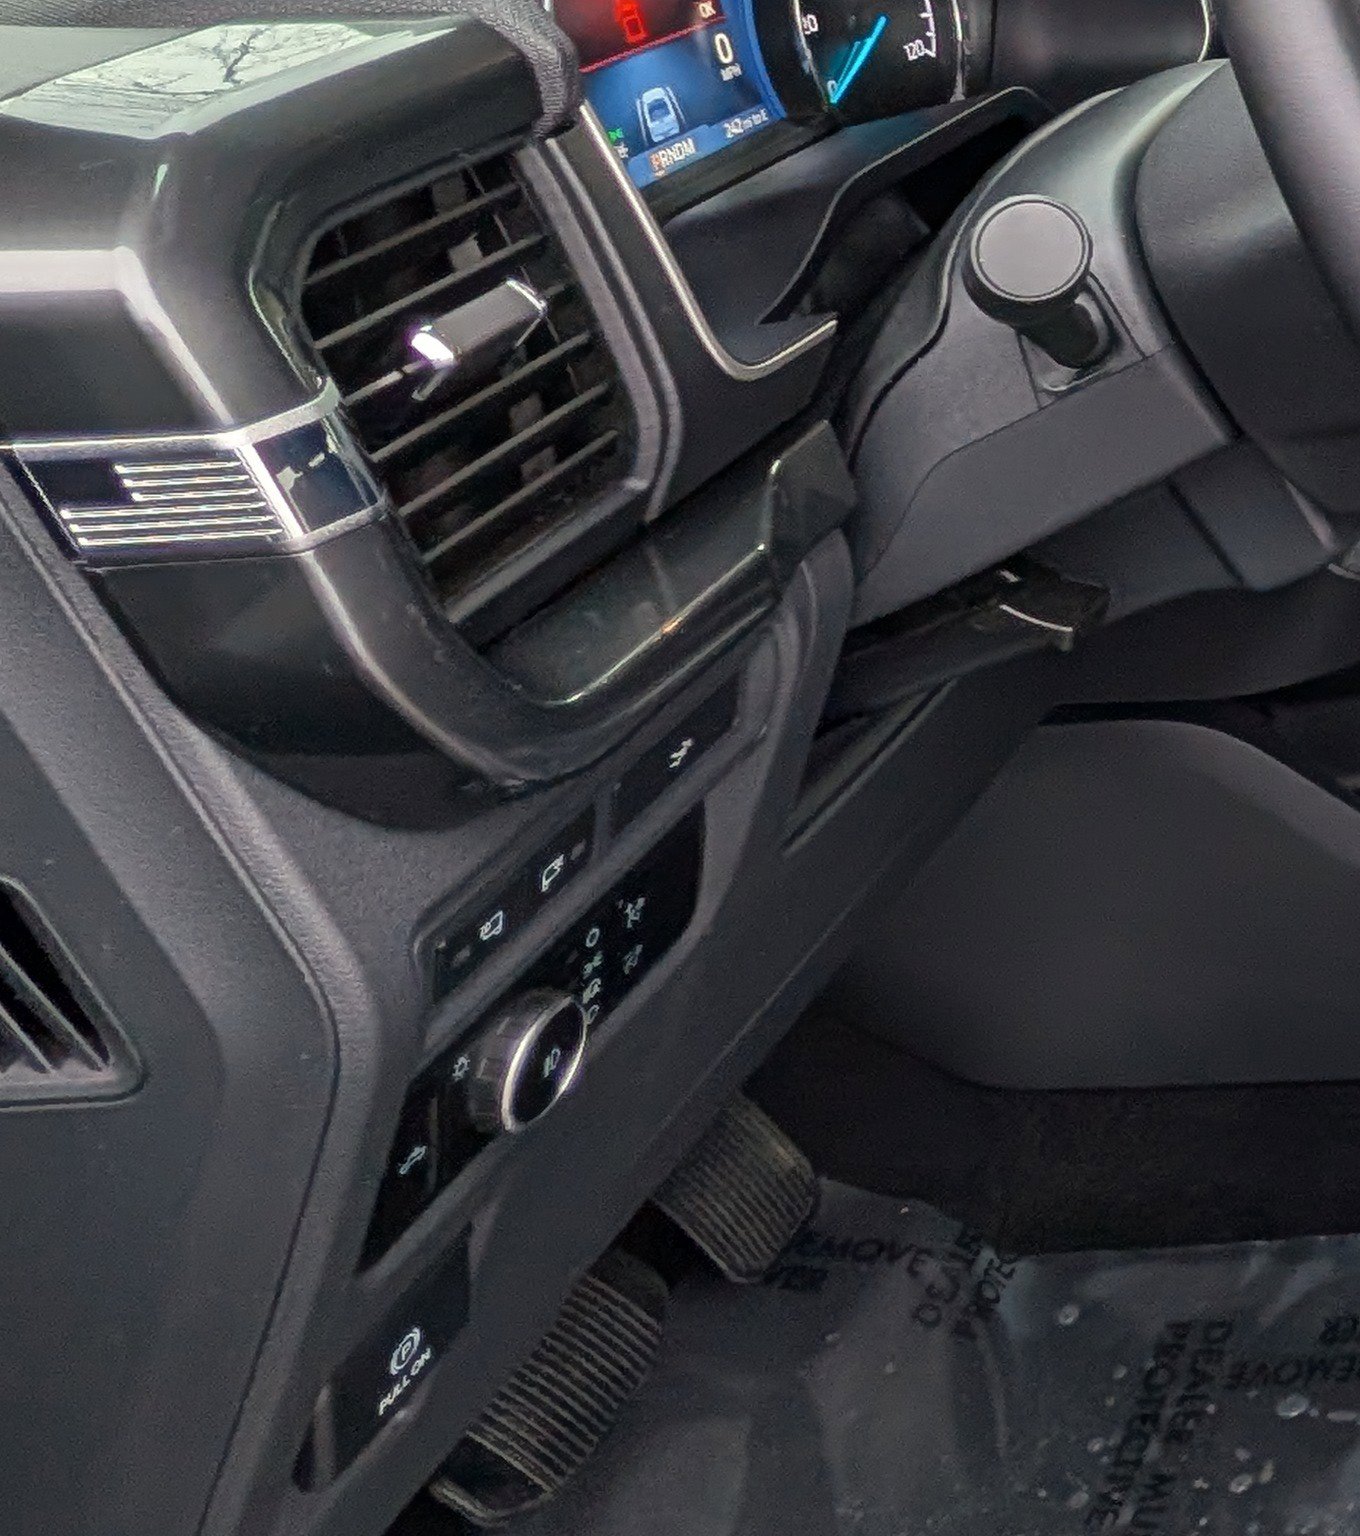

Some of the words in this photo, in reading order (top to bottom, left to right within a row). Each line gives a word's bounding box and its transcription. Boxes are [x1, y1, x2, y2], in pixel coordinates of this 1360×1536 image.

[714, 32, 734, 64] 0
[903, 39, 926, 62] 120
[378, 1374, 411, 1416] PULL
[410, 1347, 431, 1376] ON
